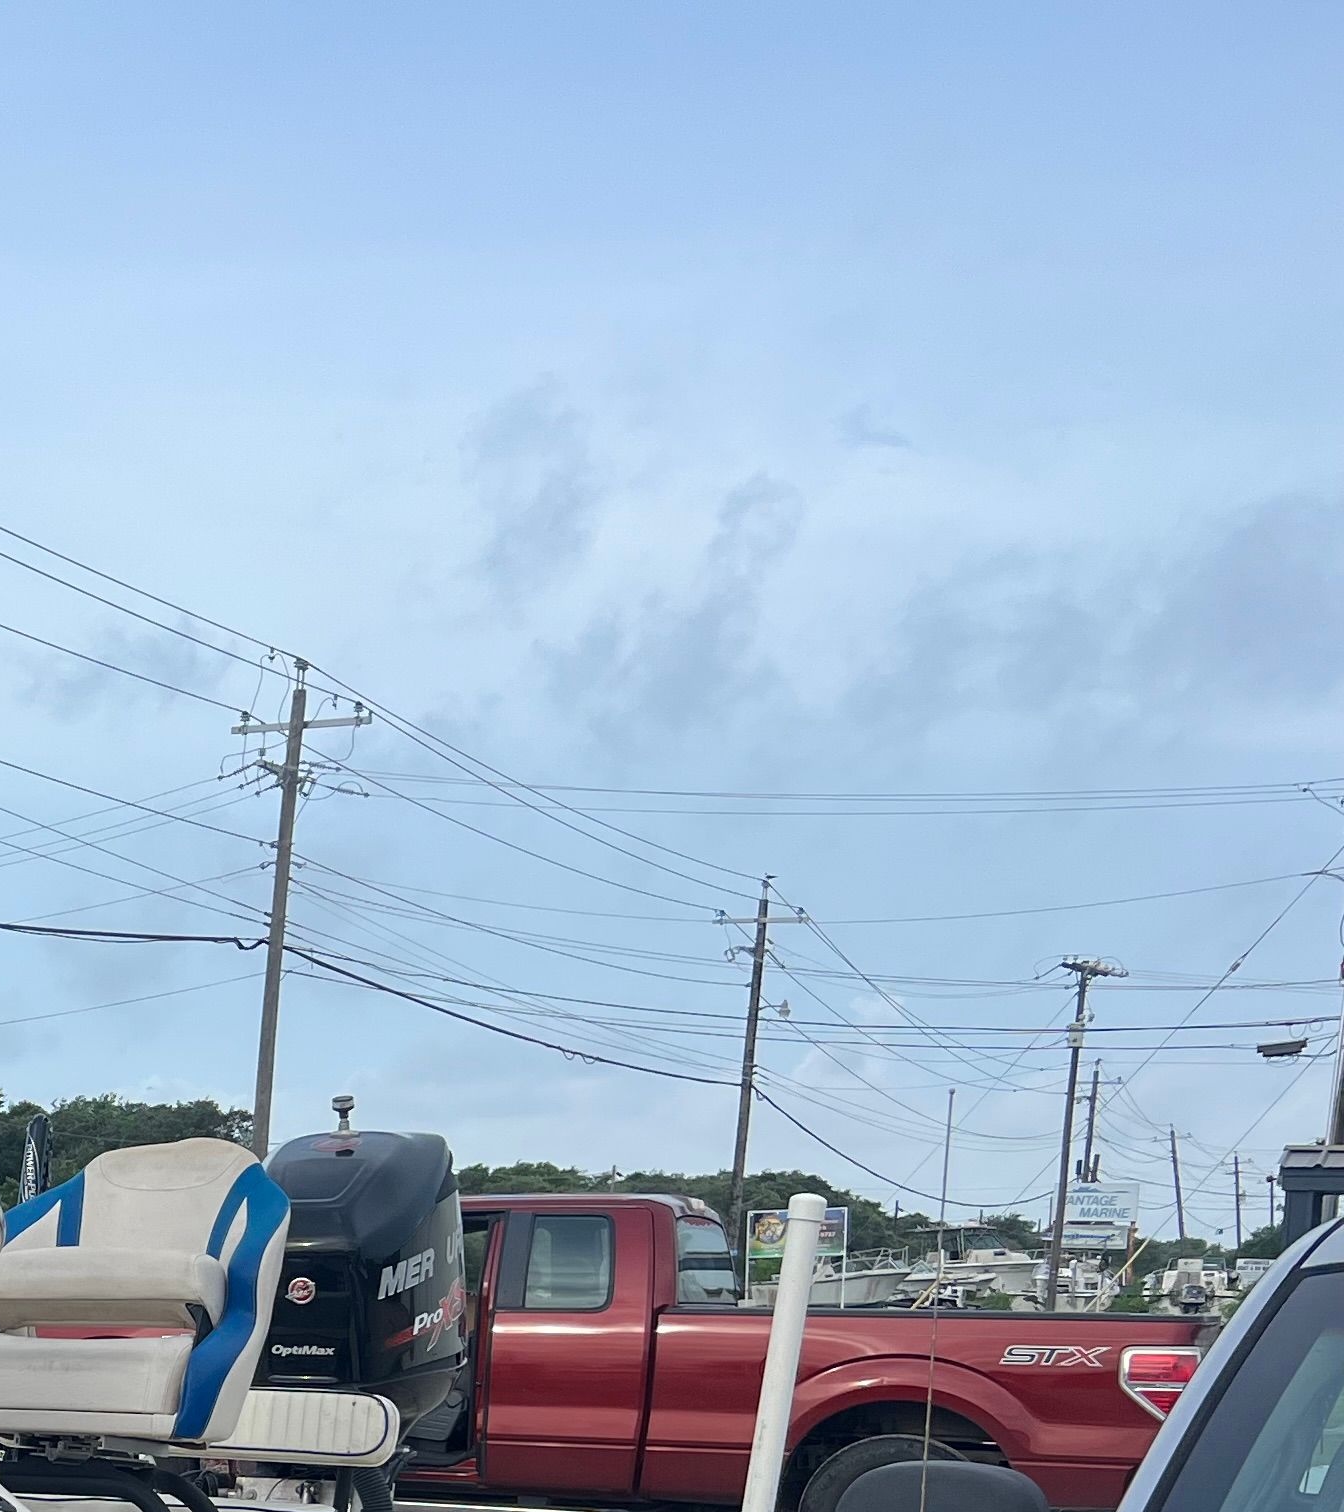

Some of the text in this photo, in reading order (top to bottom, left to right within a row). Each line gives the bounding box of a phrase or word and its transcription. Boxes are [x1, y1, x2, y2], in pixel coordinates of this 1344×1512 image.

[1079, 1207, 1131, 1219] MARINE
[271, 1344, 336, 1357] OptiMax
[999, 1345, 1112, 1368] STX
